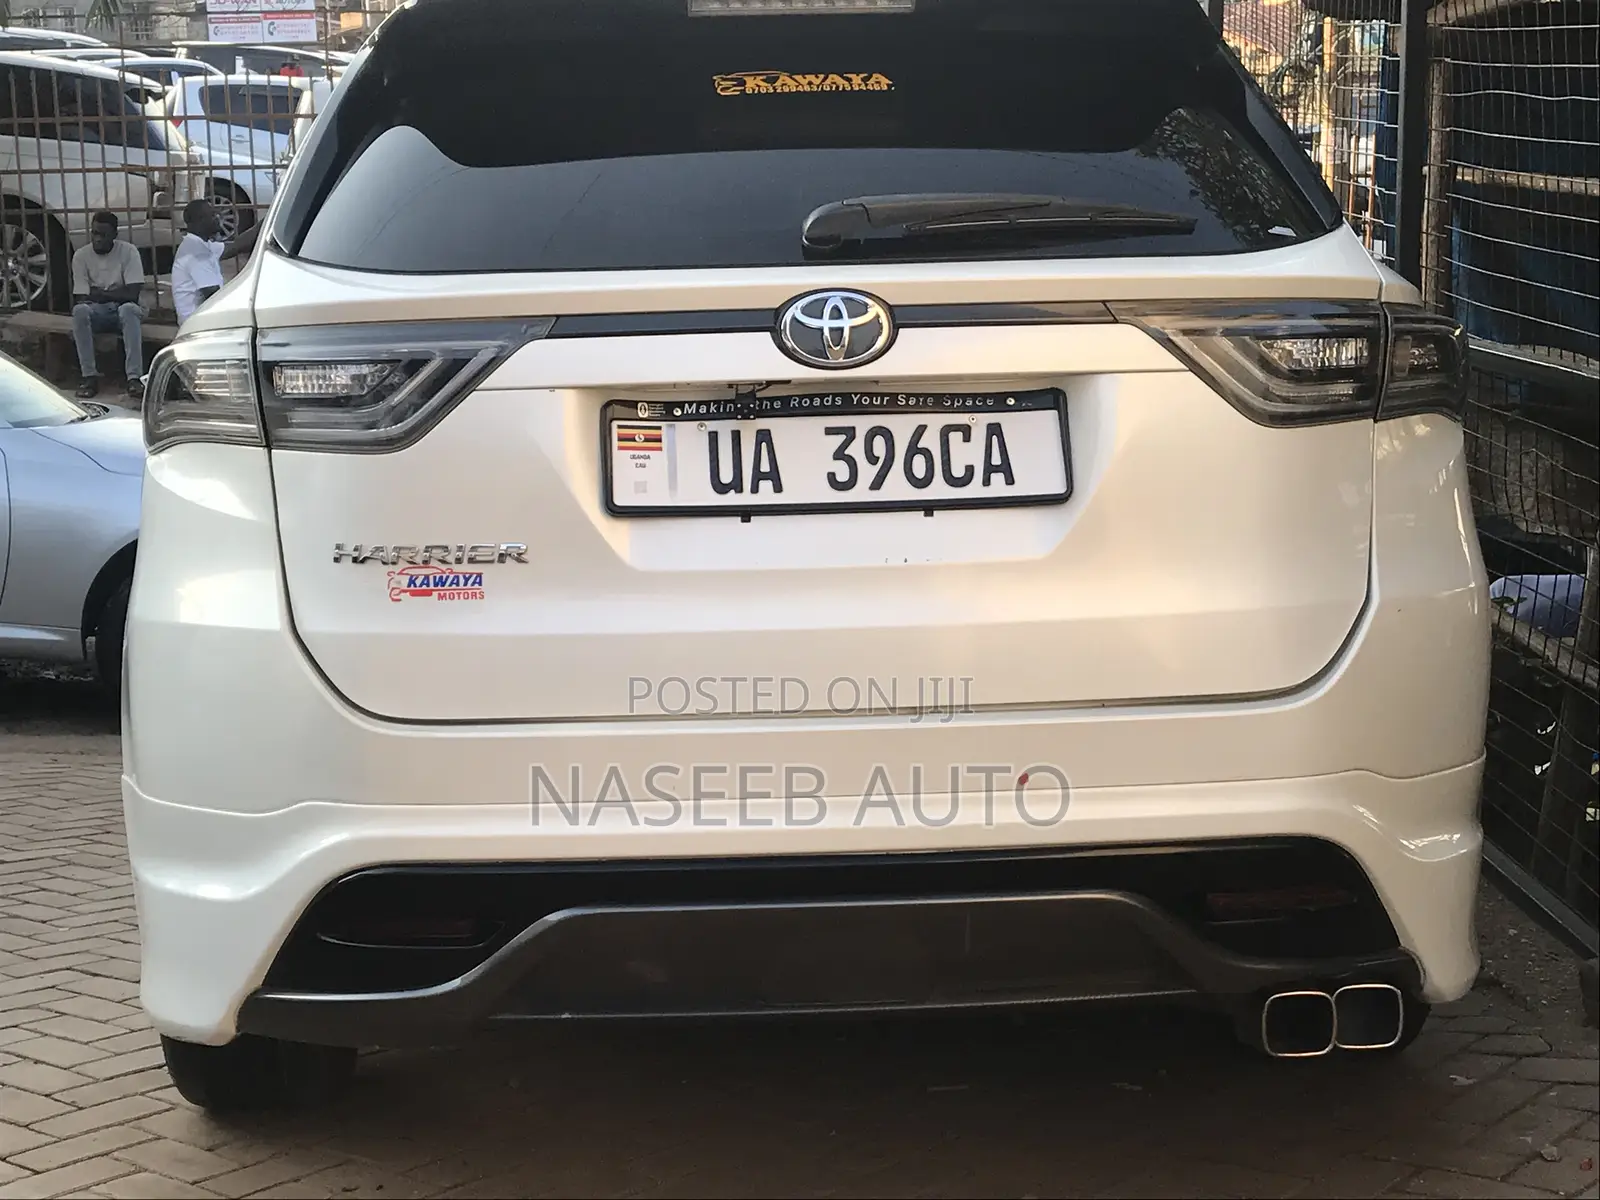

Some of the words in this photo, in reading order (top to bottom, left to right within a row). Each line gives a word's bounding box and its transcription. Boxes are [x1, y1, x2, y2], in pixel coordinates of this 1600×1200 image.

[743, 73, 893, 87] KAWAYA
[683, 402, 736, 416] Makin
[790, 395, 842, 408] Roads
[851, 393, 890, 406] Your
[942, 394, 995, 409] Space
[707, 427, 784, 495] UA
[825, 422, 1016, 492] 396CA
[333, 543, 529, 566] HARRIER
[406, 573, 484, 588] KAWAYA
[437, 591, 485, 601] MOTORS
